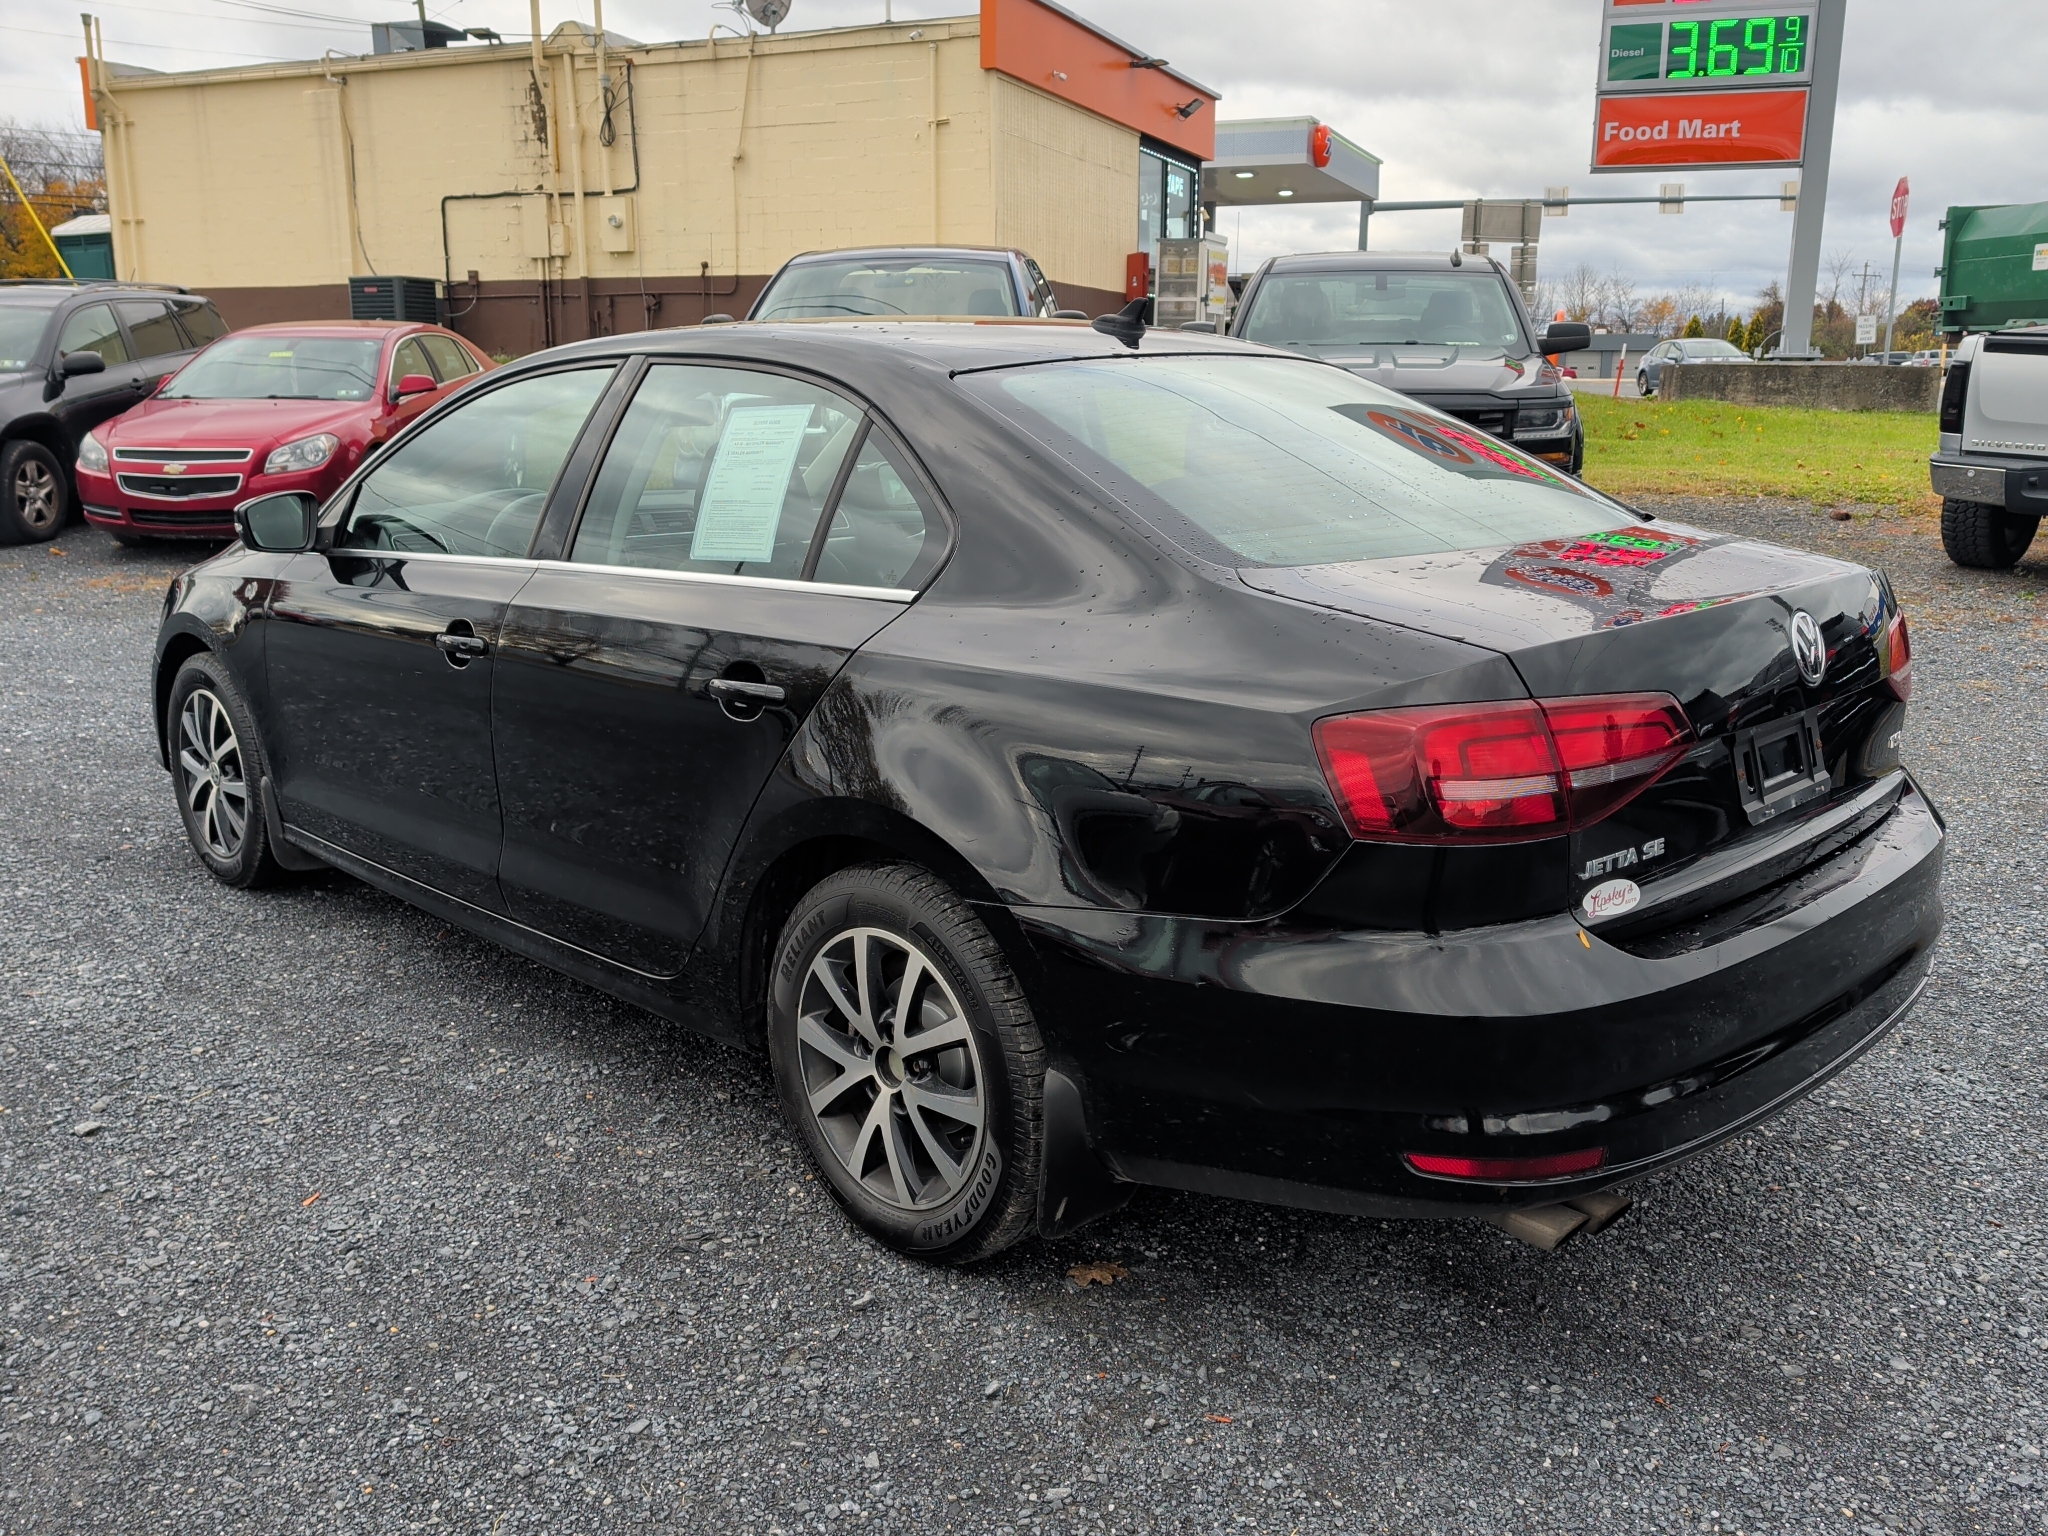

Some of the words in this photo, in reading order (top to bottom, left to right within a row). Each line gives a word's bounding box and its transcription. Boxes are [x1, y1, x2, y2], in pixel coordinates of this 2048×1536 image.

[1611, 47, 1644, 58] Diesel
[1667, 17, 1776, 79] 3.69
[1785, 16, 1800, 42] 9
[1779, 47, 1800, 73] 10
[1604, 120, 1669, 142] Food
[1678, 118, 1742, 139] Mart
[1891, 194, 1909, 220] STOP
[1579, 847, 1639, 881] JETTA
[1642, 837, 1665, 861] SE
[1589, 882, 1634, 918] Lipsky's
[780, 909, 826, 983] RELIANT
[926, 935, 980, 1011] ALL-SEASON
[921, 1152, 997, 1243] GOODYEAR
